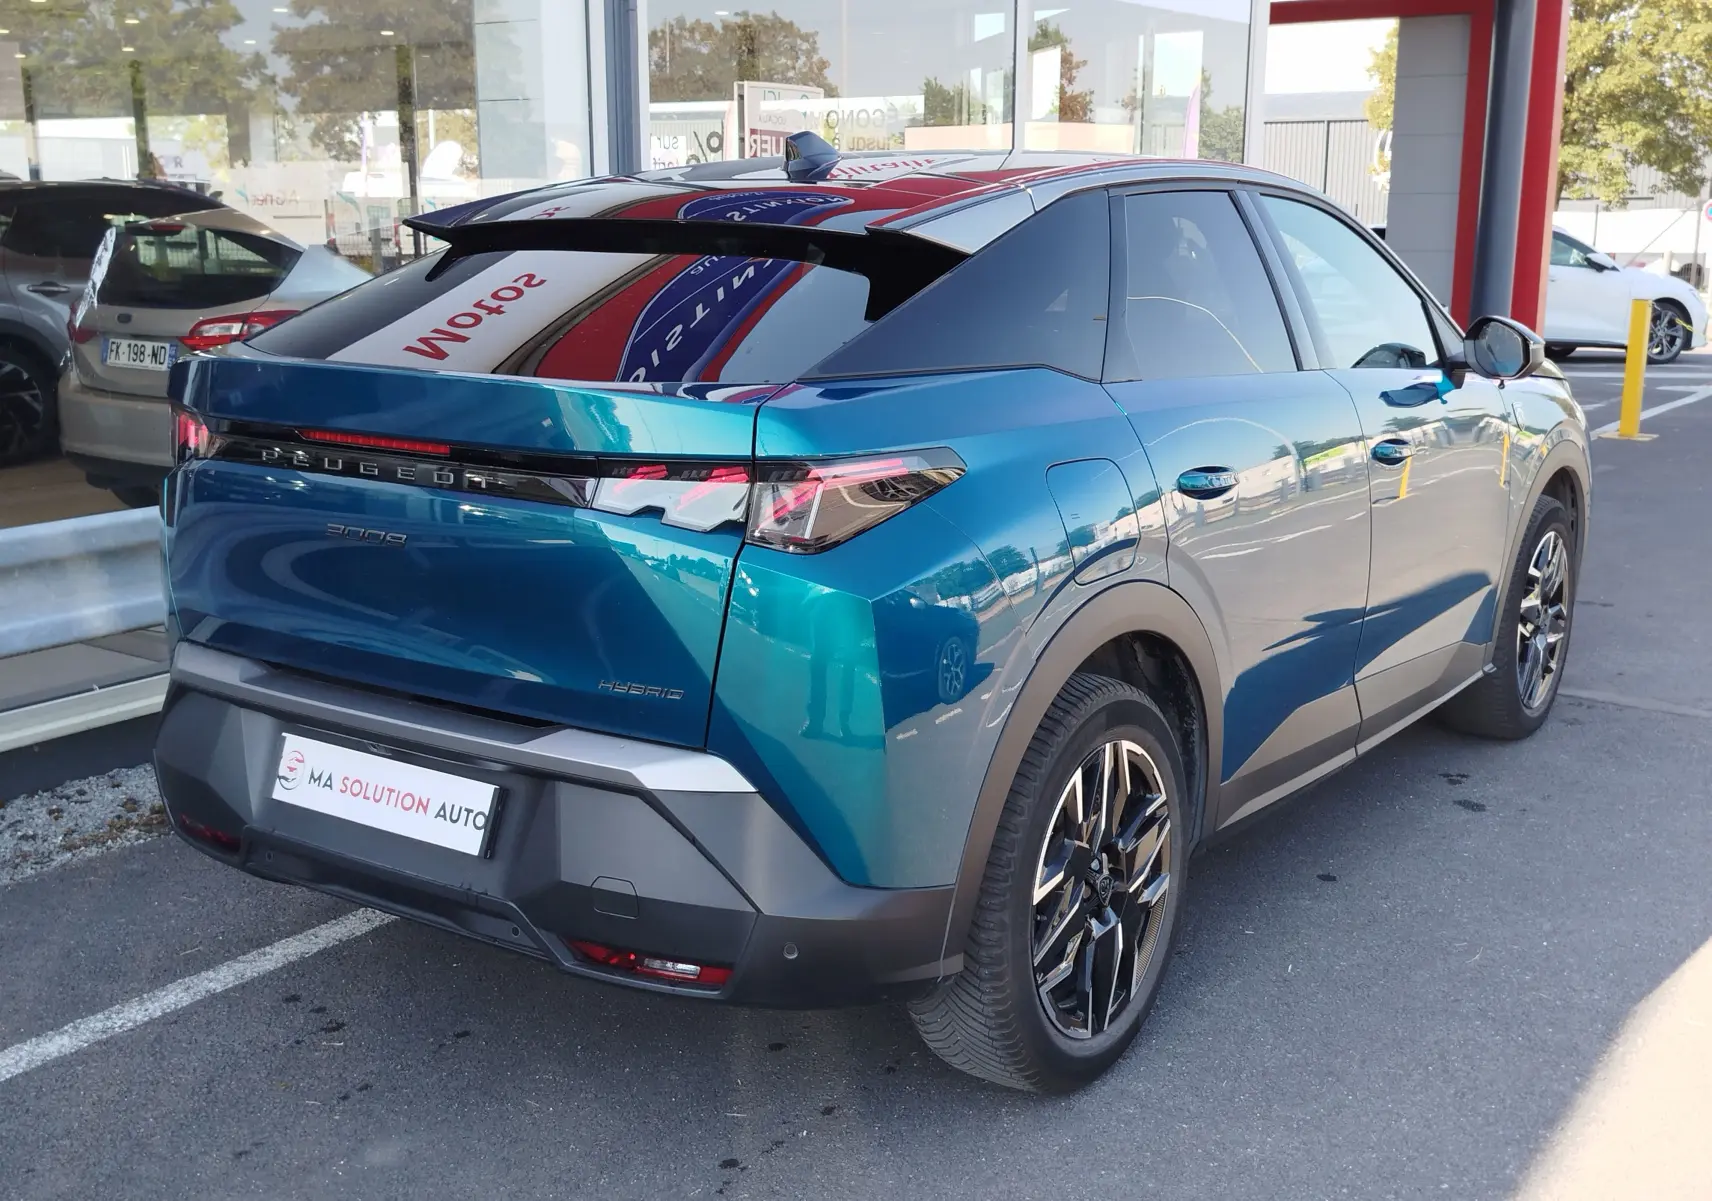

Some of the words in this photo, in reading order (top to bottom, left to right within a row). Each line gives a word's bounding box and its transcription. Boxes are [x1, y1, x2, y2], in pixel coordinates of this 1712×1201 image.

[108, 341, 167, 366] FK-198-ND
[261, 448, 488, 490] PEUGEOT
[326, 522, 408, 546] 3008
[598, 679, 685, 700] HYBRID
[308, 767, 334, 791] MA
[339, 776, 431, 816] SOLUTION
[434, 802, 487, 831] AUTO
